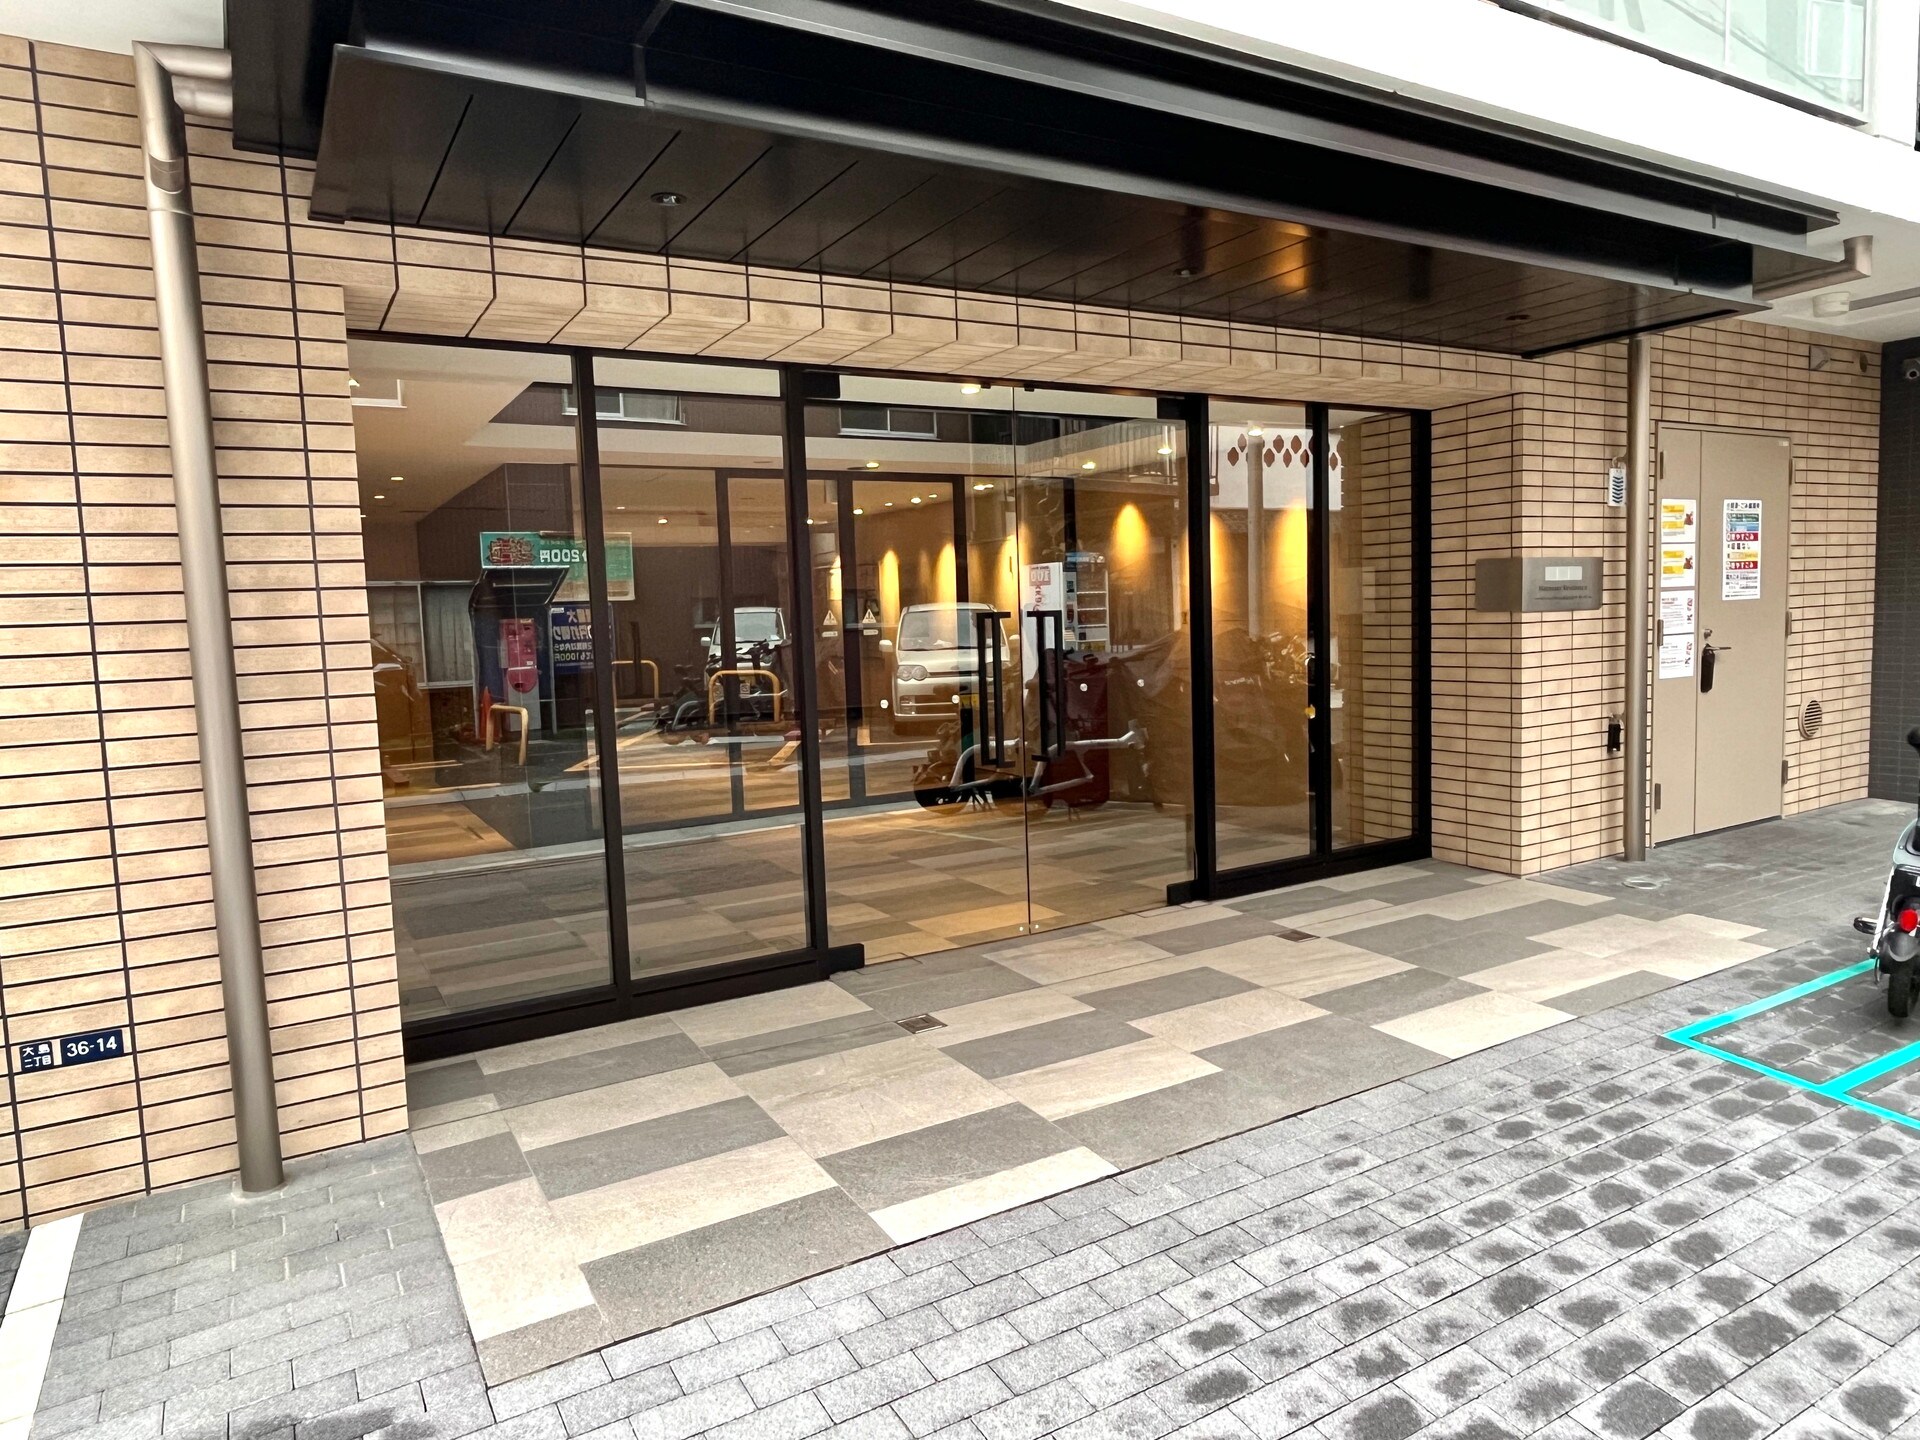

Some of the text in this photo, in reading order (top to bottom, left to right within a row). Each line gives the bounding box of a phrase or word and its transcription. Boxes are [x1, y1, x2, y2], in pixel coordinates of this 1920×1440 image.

[66, 1036, 117, 1057] 36-14
[24, 1055, 52, 1068] 二丁目
